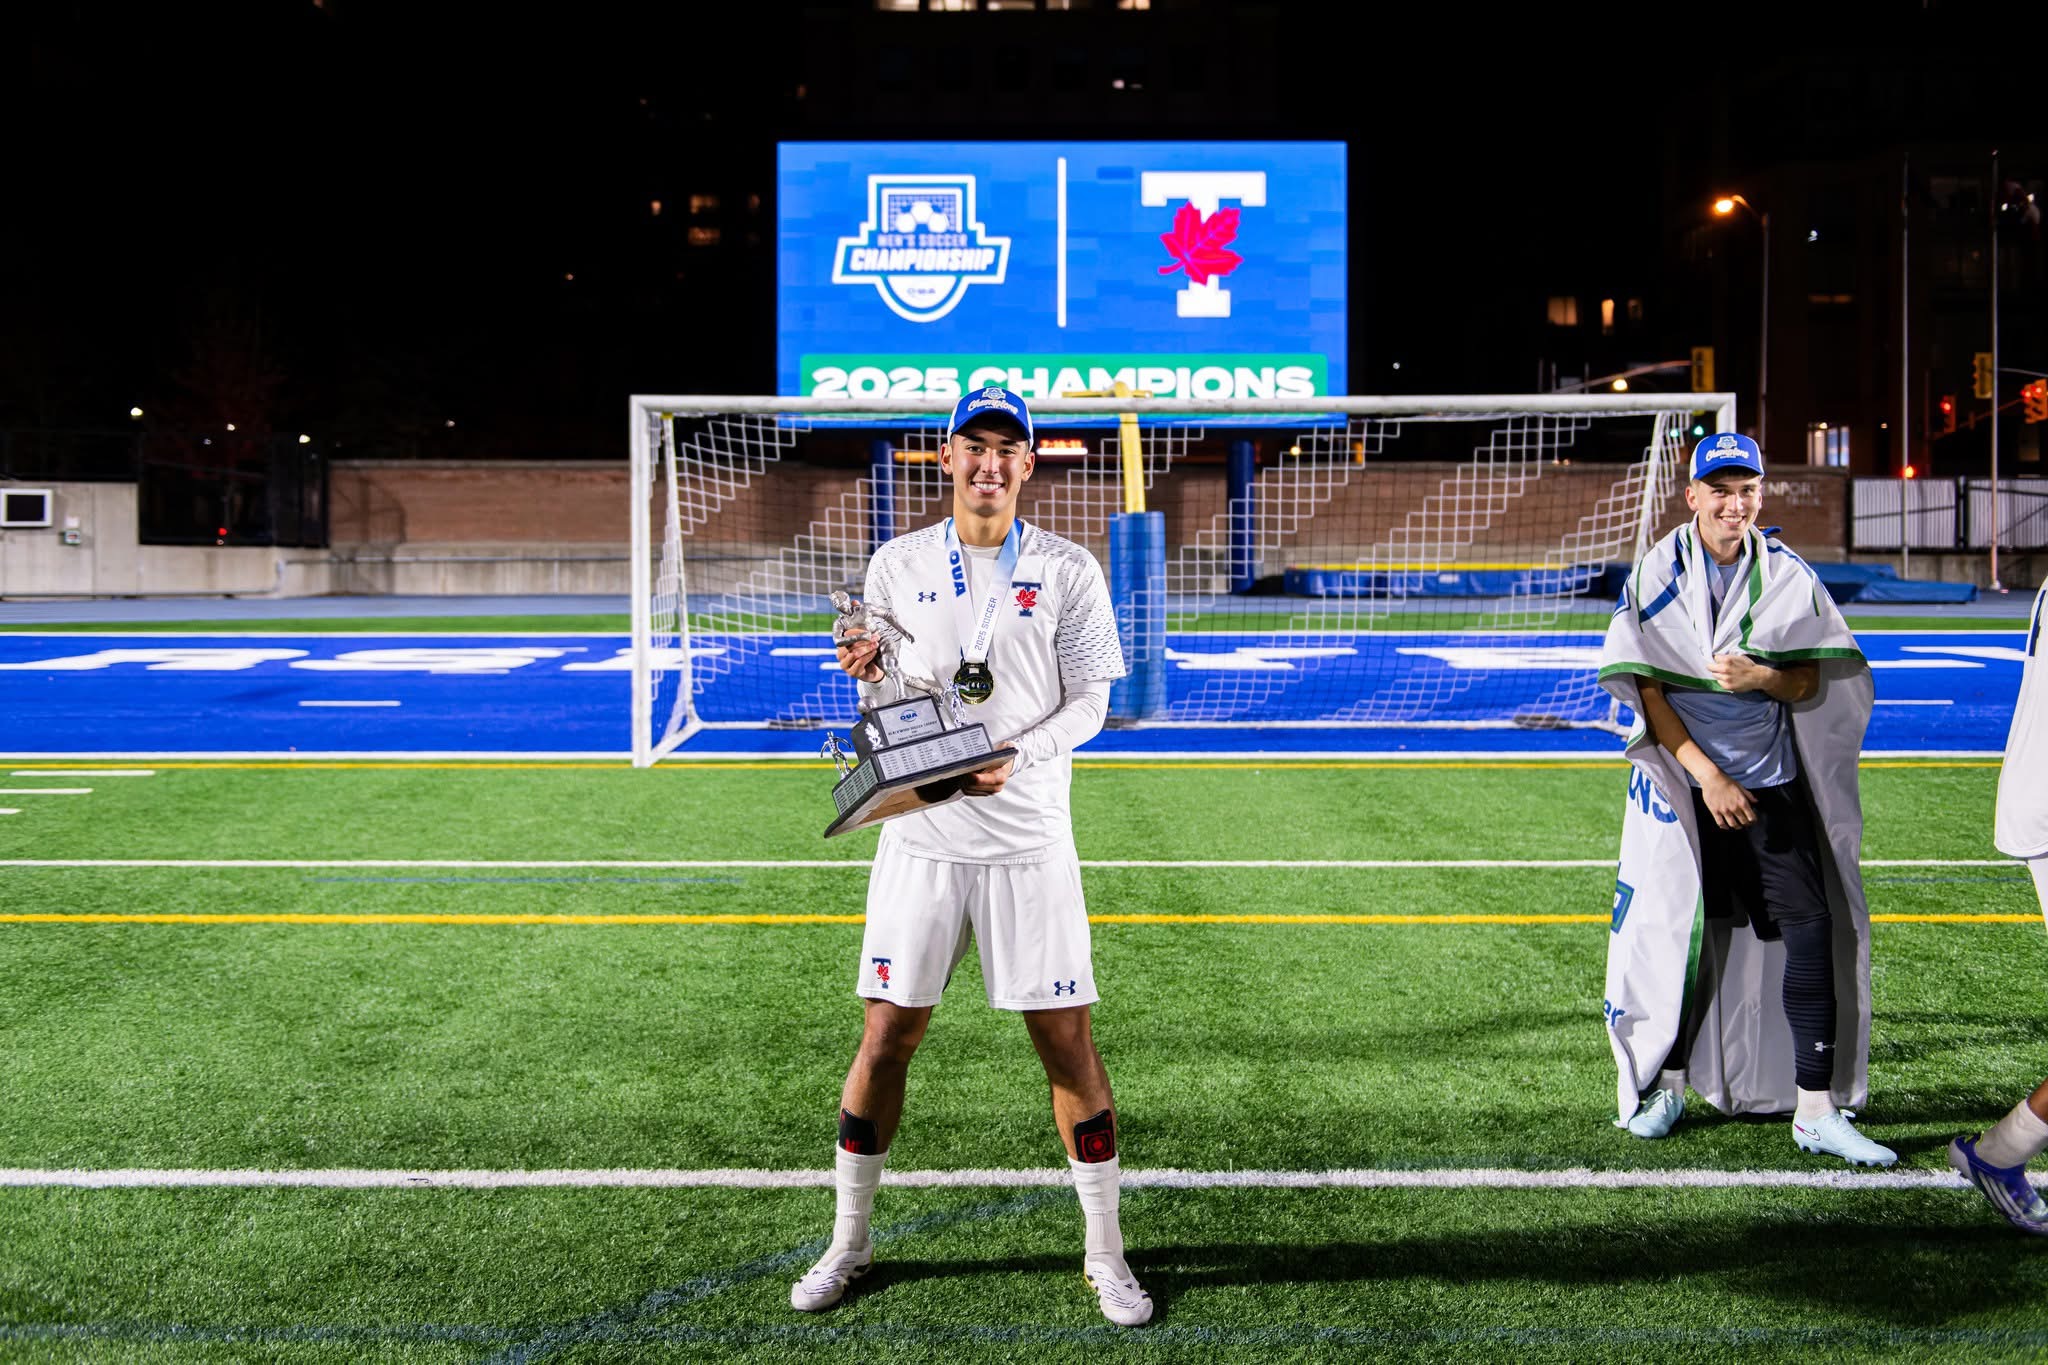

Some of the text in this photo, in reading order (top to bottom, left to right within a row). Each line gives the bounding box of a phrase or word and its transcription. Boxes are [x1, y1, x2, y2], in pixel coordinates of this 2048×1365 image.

[919, 234, 968, 247] SOCCER
[850, 247, 996, 271] CHAMPIONSHIP
[811, 366, 1316, 399] 2025 CHAMPIONS
[949, 550, 967, 598] OUA
[974, 597, 998, 651] 2025 SOCCER
